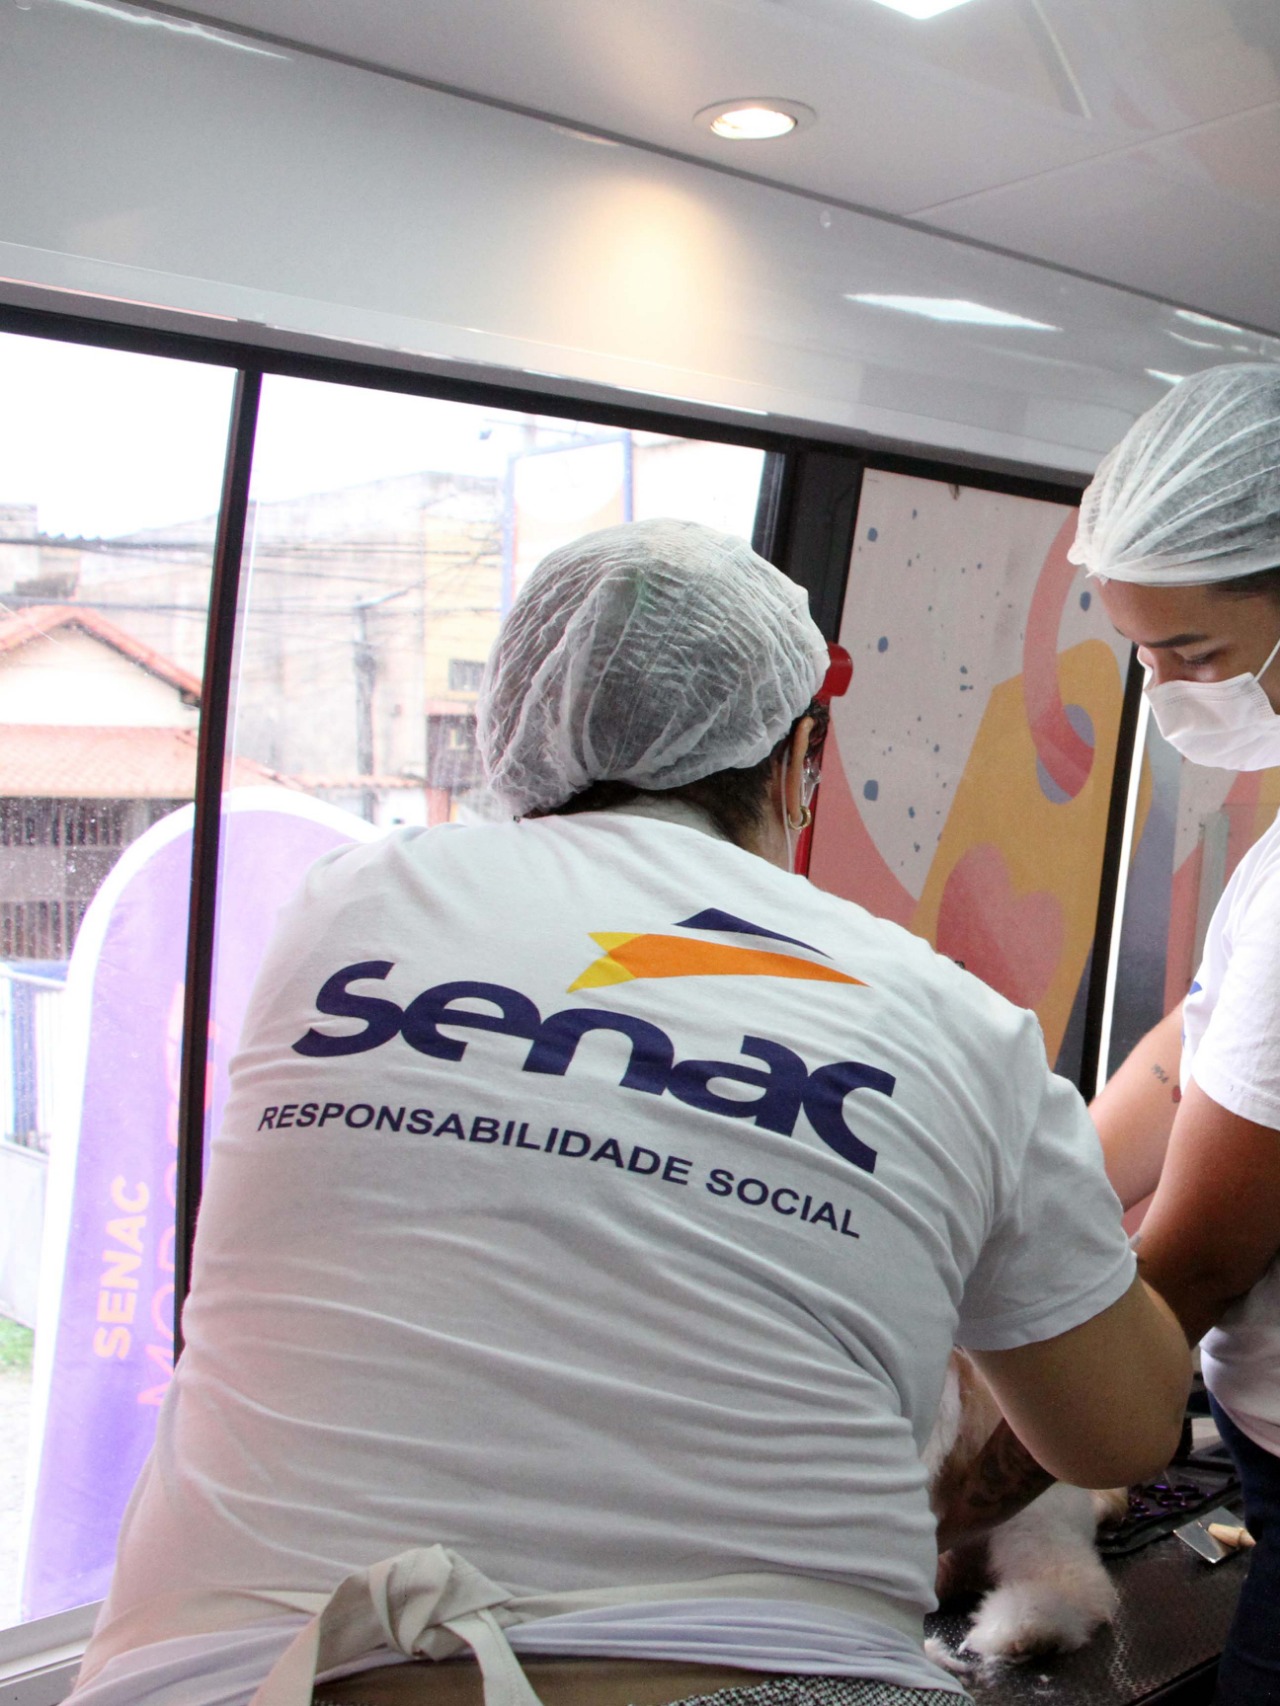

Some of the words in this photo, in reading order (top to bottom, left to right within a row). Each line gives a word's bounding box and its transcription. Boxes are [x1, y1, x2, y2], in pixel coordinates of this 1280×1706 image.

[257, 1102, 694, 1186] RESPONSABILIDADE
[705, 1168, 861, 1239] SOCIAL
[94, 1175, 150, 1360] SENAC
